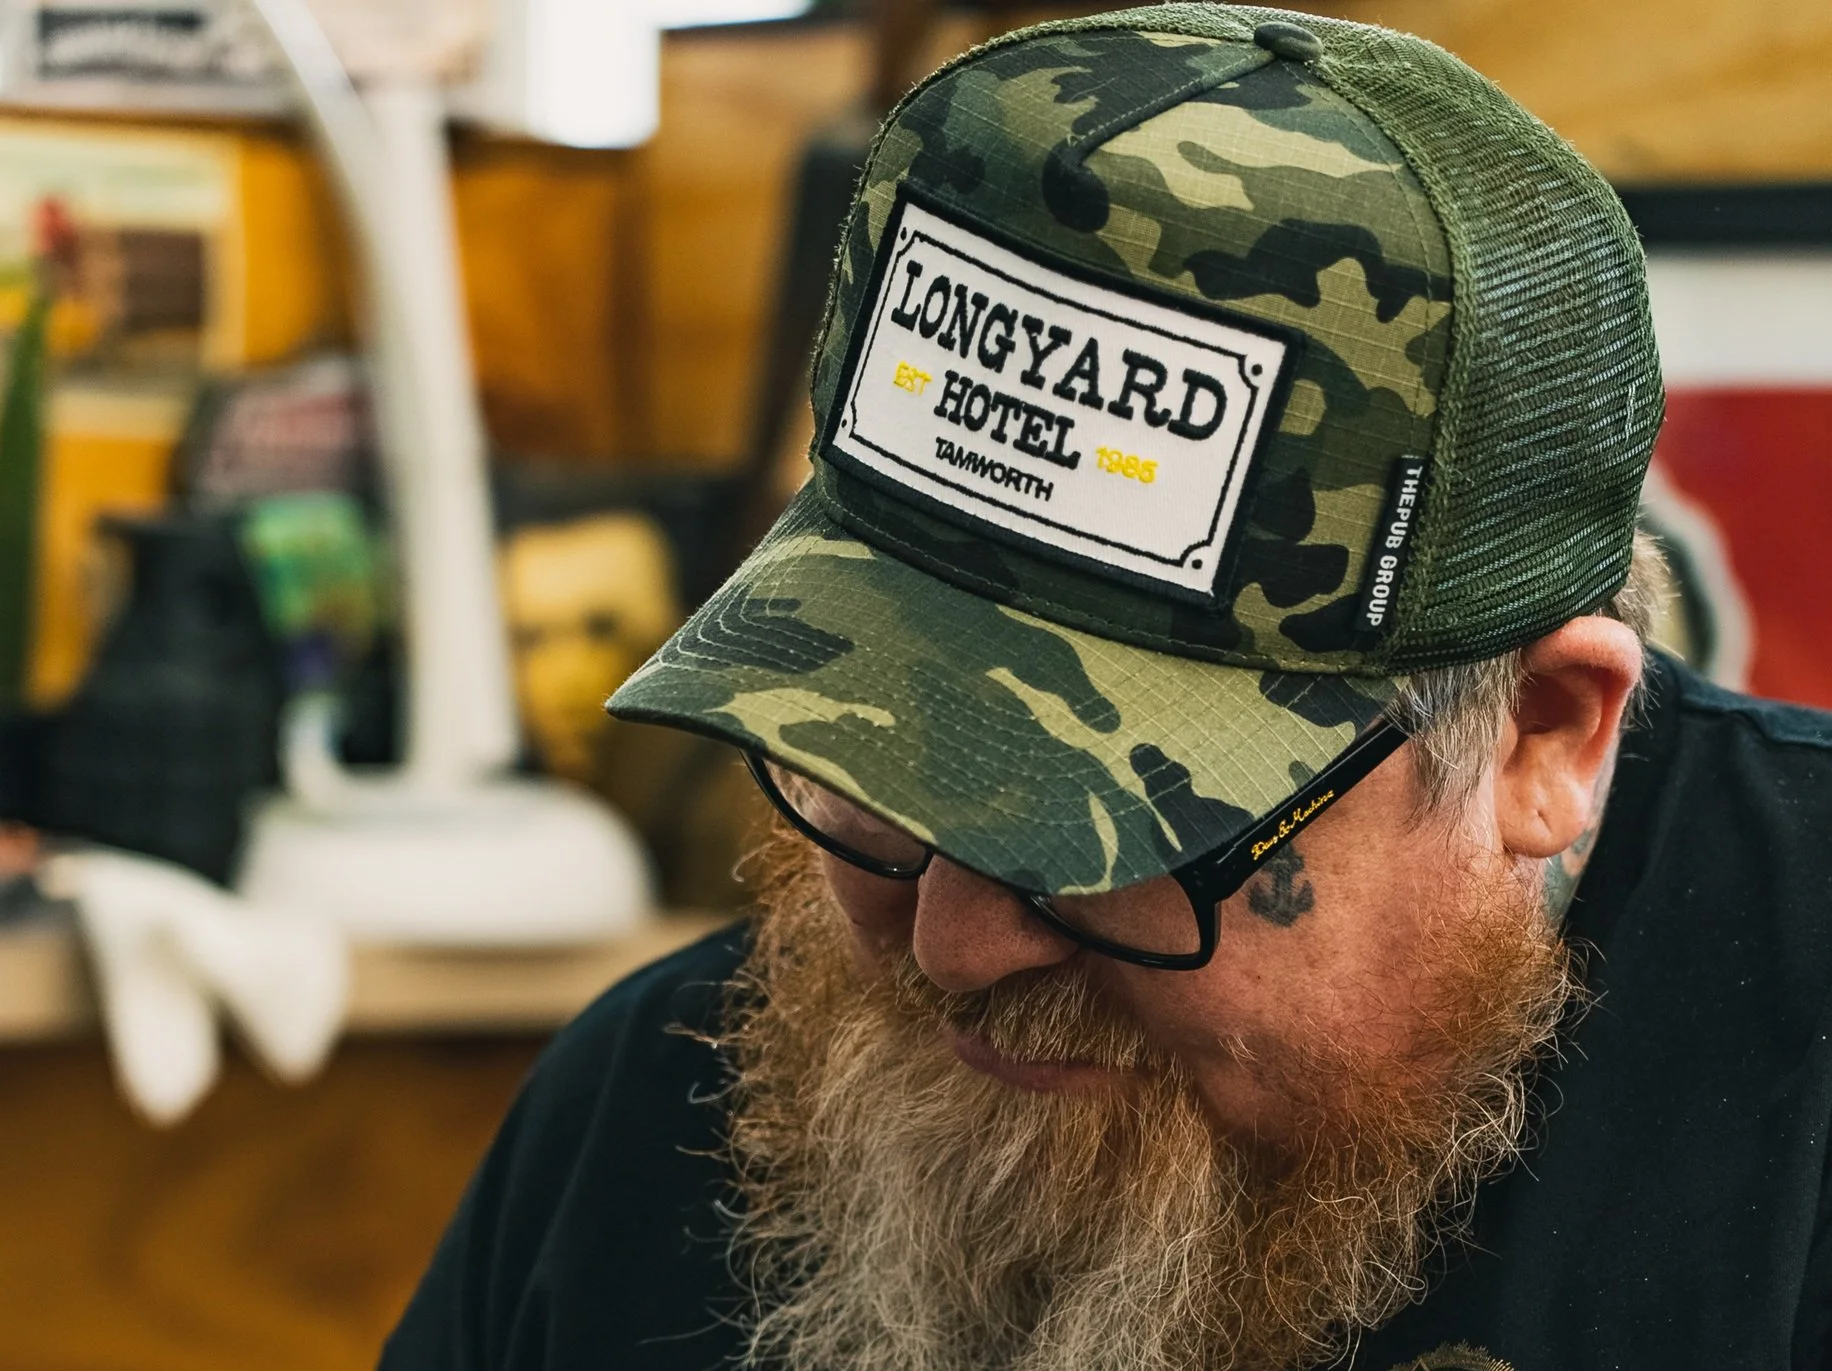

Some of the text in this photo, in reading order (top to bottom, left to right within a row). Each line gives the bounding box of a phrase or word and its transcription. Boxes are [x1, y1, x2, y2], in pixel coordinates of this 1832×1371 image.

[891, 259, 1227, 441] LONGYARD
[893, 360, 933, 397] EST
[934, 369, 1081, 470] HOTEL
[935, 436, 1054, 501] TAMWORTH
[1366, 555, 1398, 627] GROUP
